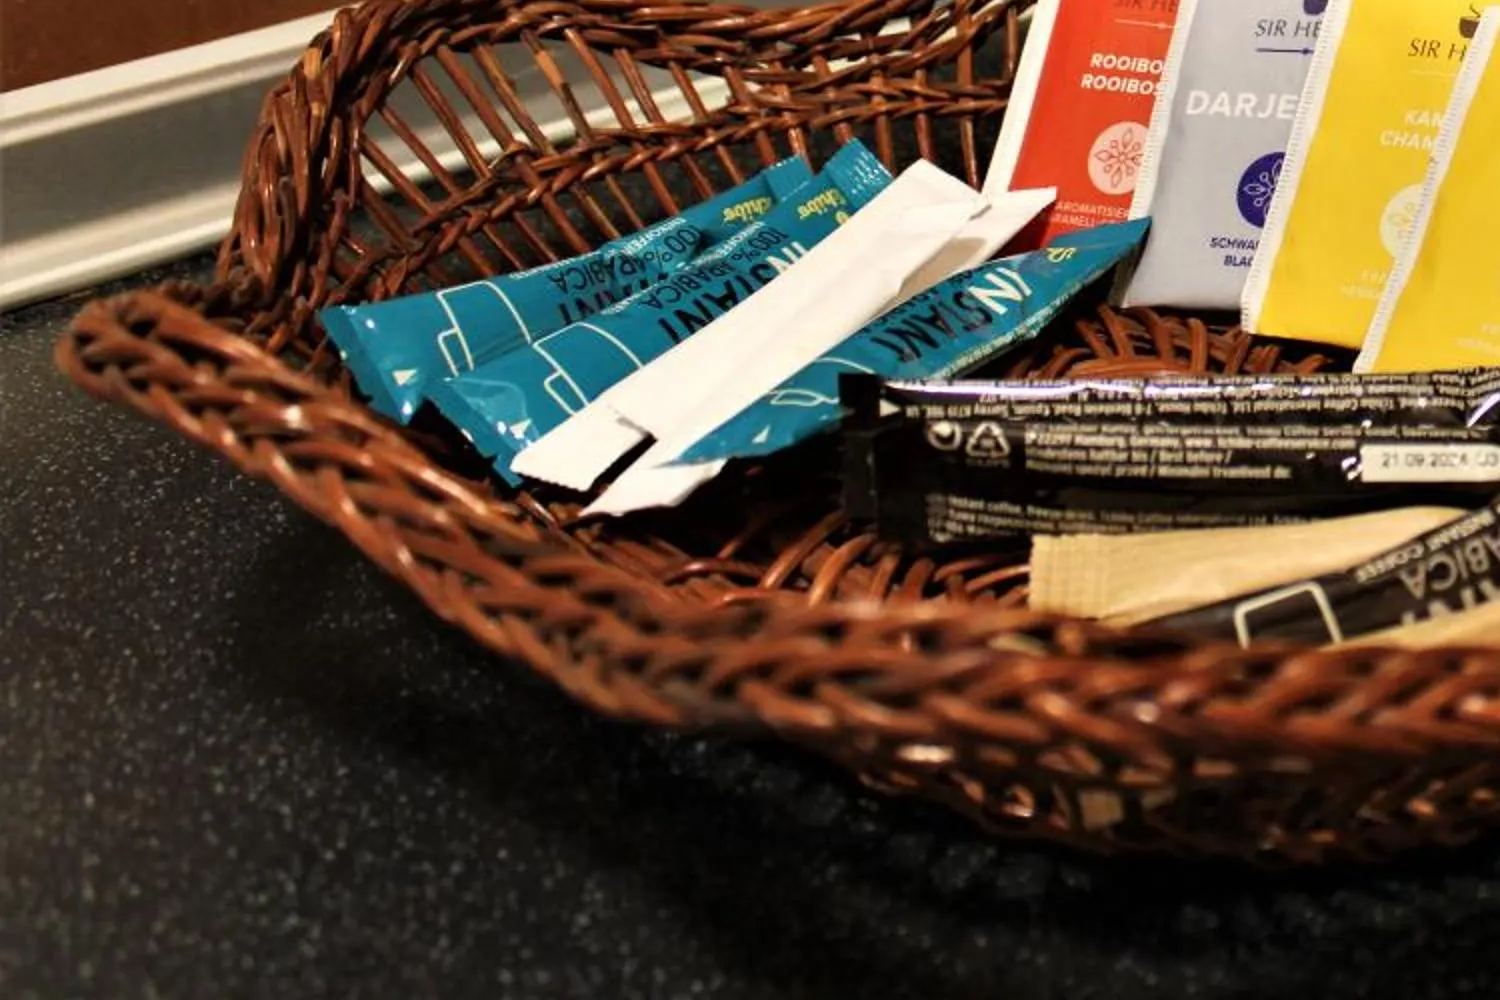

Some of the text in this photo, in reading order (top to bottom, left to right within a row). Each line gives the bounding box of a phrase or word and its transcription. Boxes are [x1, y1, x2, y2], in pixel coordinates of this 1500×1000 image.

[1254, 18, 1324, 39] SIR HE
[1407, 37, 1442, 59] SIR
[1185, 89, 1301, 120] DARJE
[1209, 237, 1260, 250] SCHWA
